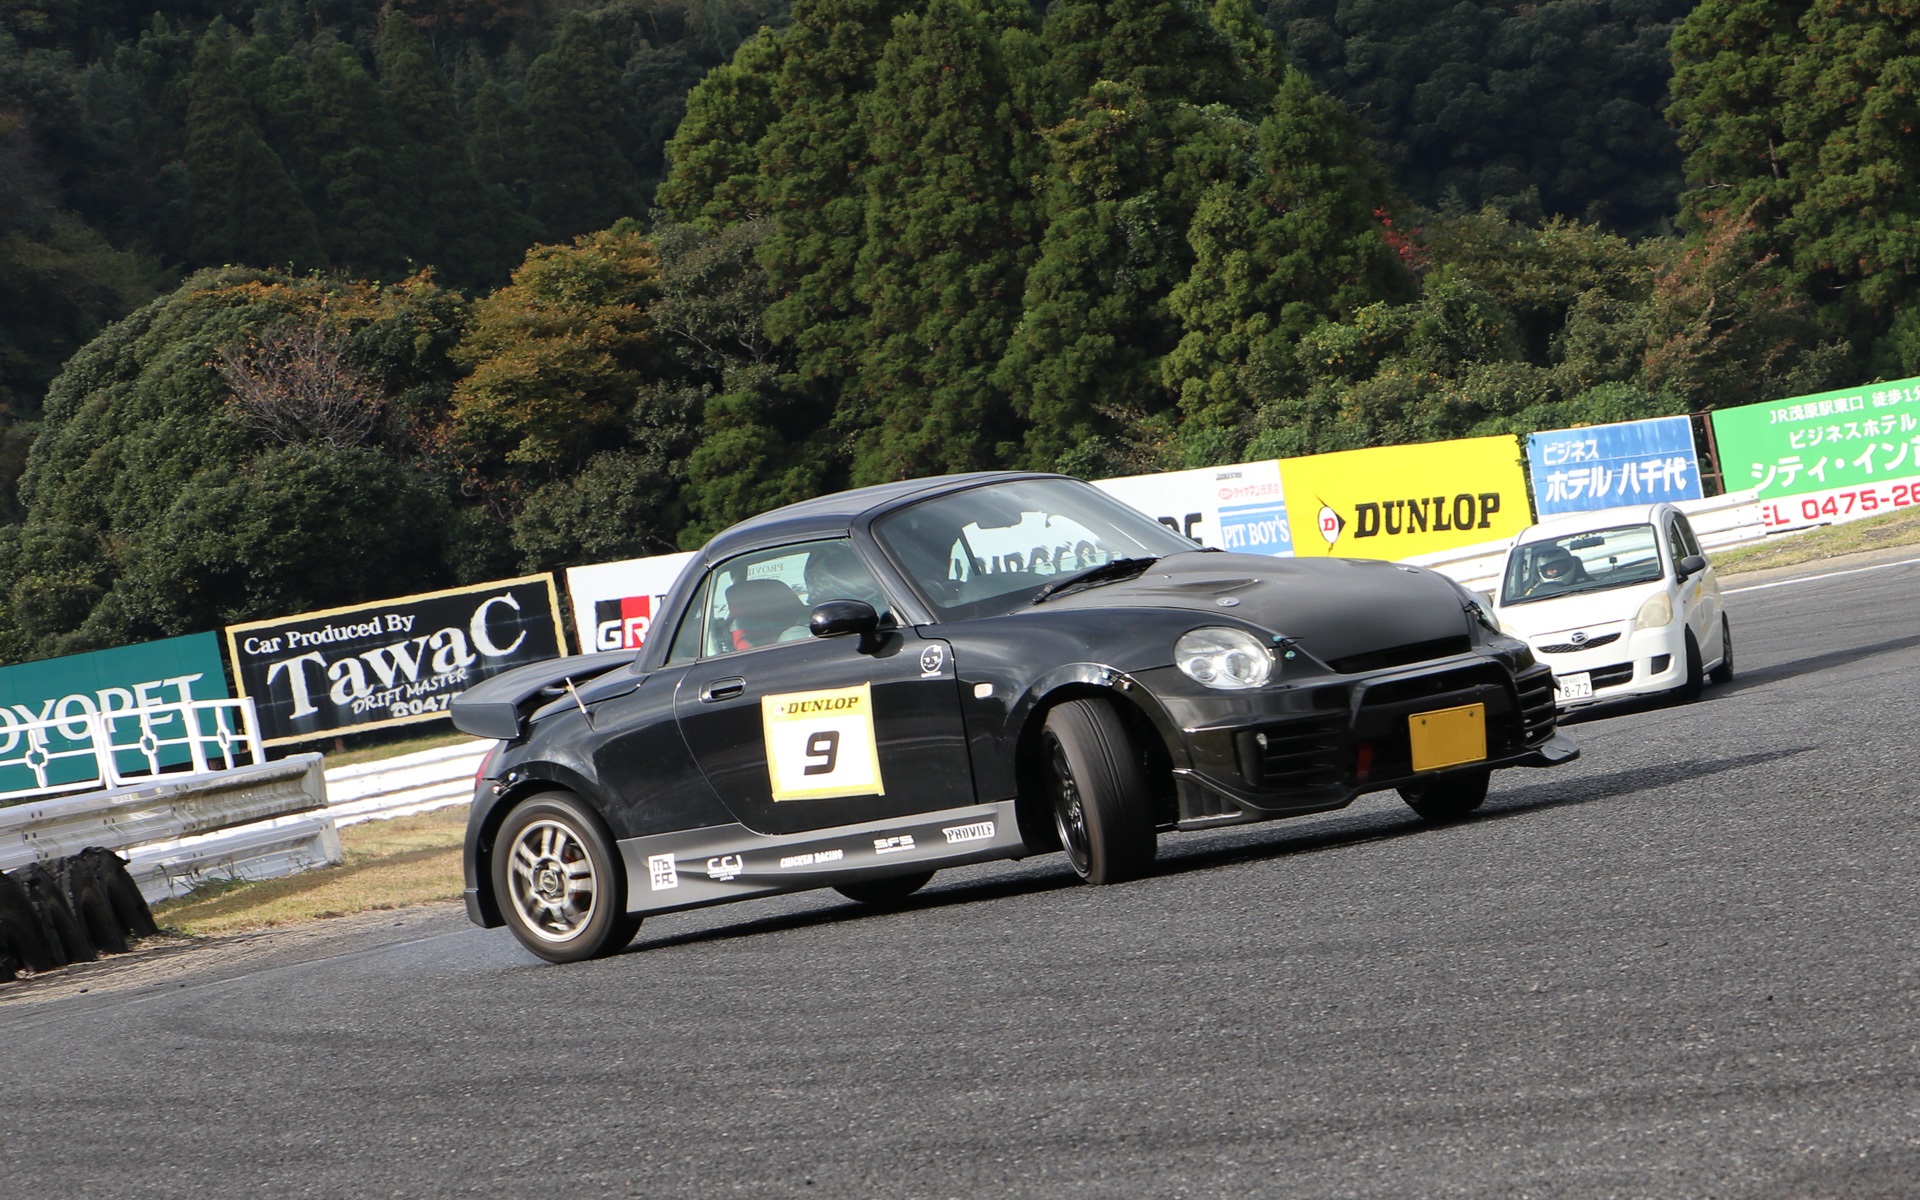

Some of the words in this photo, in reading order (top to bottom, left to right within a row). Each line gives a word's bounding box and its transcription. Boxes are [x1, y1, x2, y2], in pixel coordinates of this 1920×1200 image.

[1790, 413, 1918, 449] ビジネスホテル
[1543, 439, 1600, 465] ビジネス
[1221, 523, 1247, 549] PIT
[1247, 514, 1290, 546] BOY'S
[1354, 492, 1500, 538] DUNLOP
[244, 635, 281, 656] Car
[286, 615, 383, 648] Produced
[384, 613, 416, 633] By
[597, 616, 650, 651] GR
[267, 592, 527, 720] TawaC
[351, 684, 404, 715] DRIFT
[405, 667, 469, 698] MASTER
[787, 697, 859, 714] DUNLOP
[804, 730, 840, 776] 9
[873, 834, 914, 848] SFS
[947, 823, 994, 841] PROVILE
